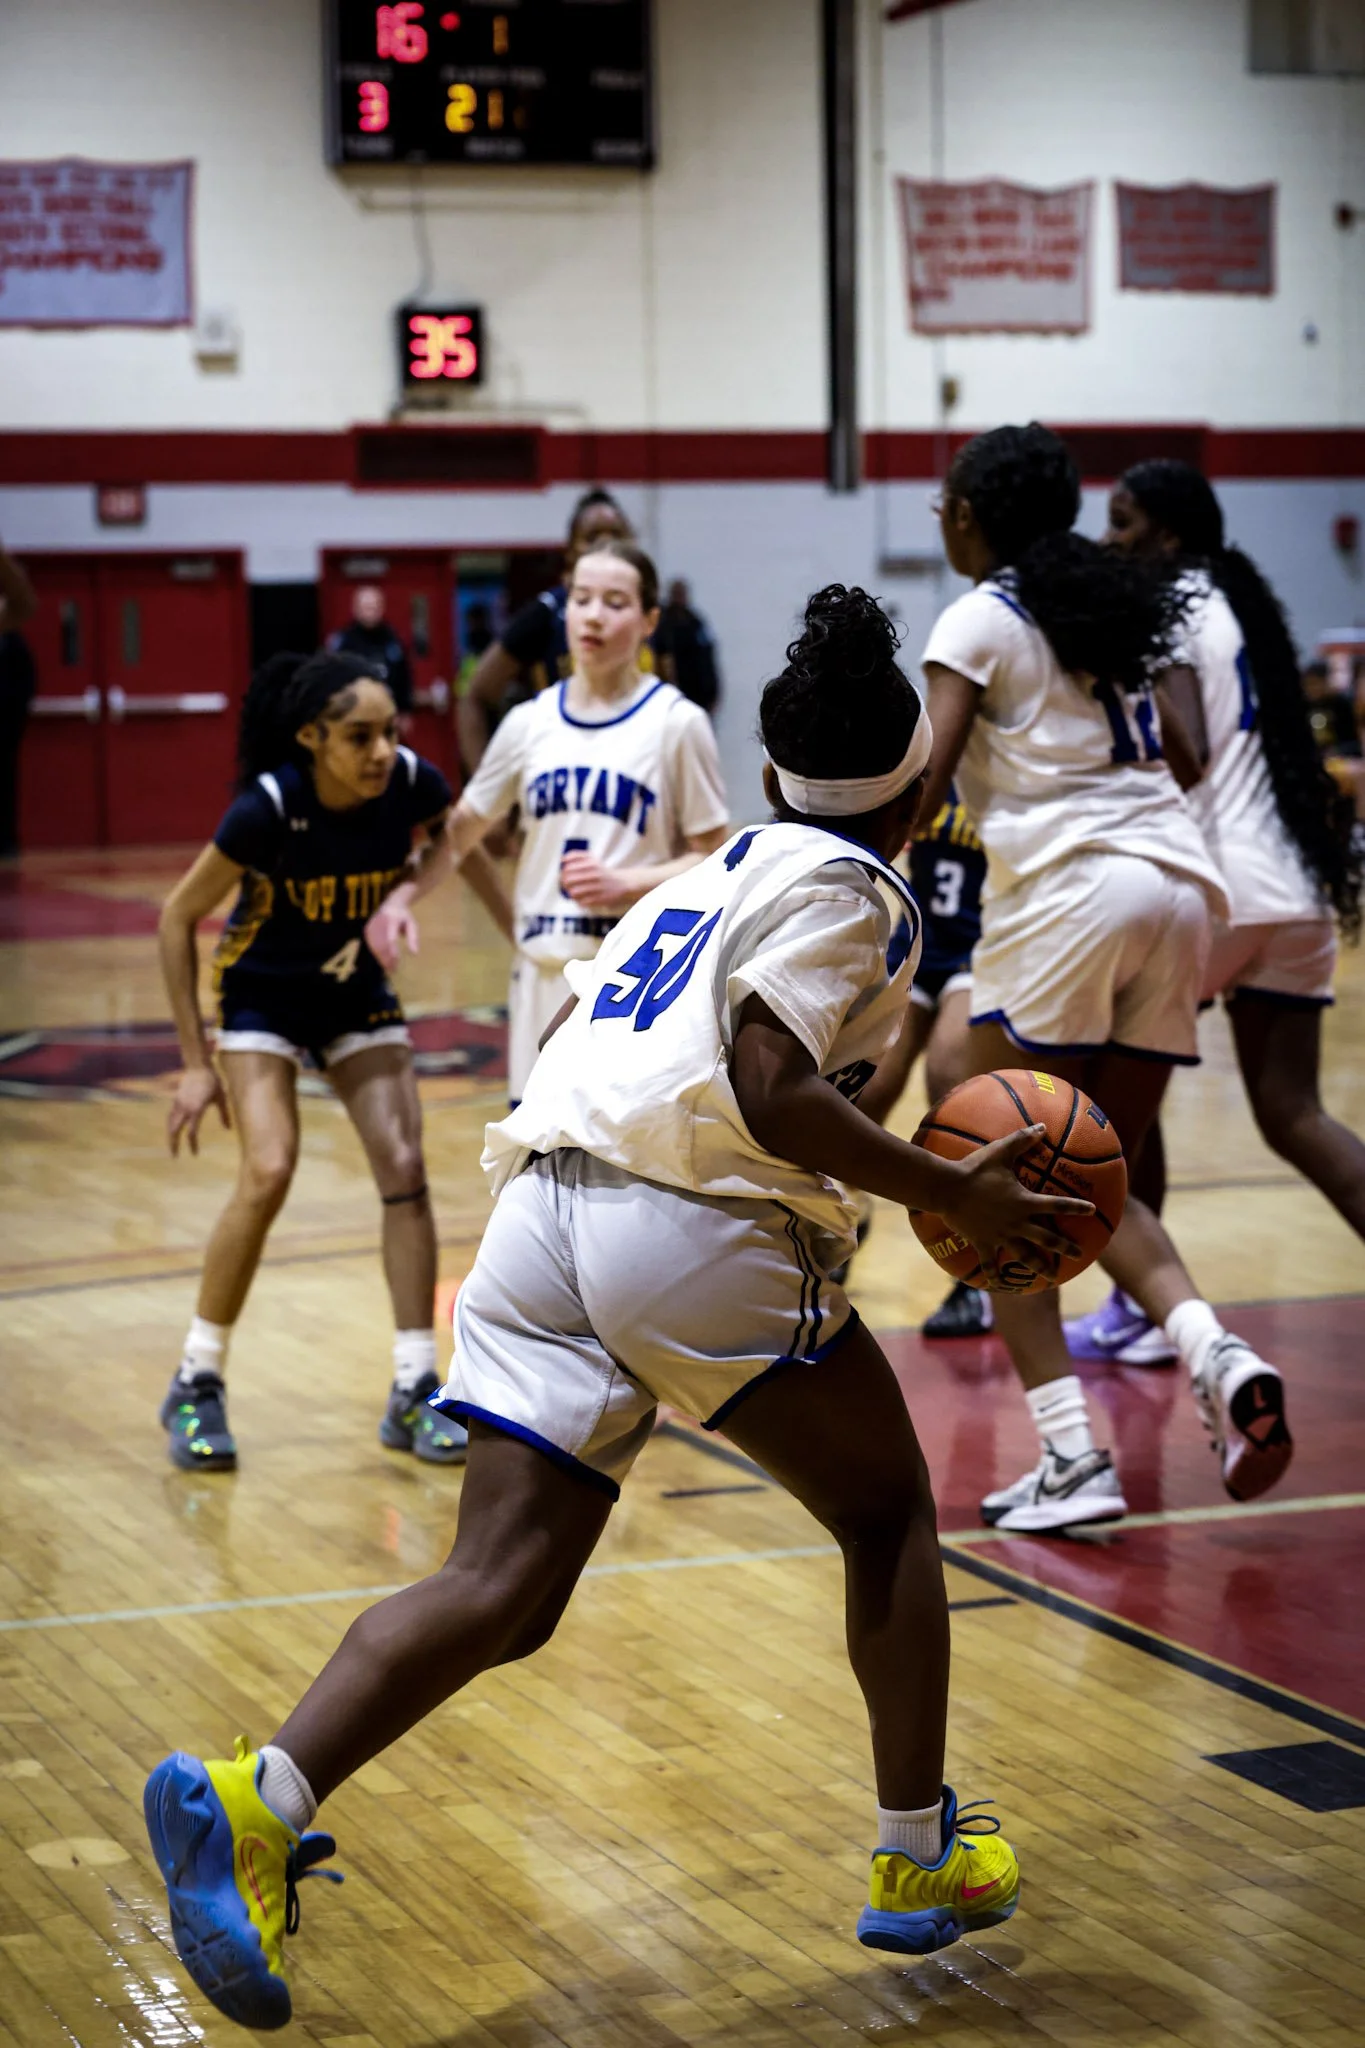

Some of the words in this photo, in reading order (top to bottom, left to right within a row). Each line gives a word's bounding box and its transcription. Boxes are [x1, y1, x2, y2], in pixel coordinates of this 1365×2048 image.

[376, 2, 428, 63] 16
[358, 81, 389, 132] 3
[408, 314, 477, 378] 35
[930, 859, 965, 917] 3
[320, 937, 361, 984] 4
[590, 907, 724, 1032] 50
